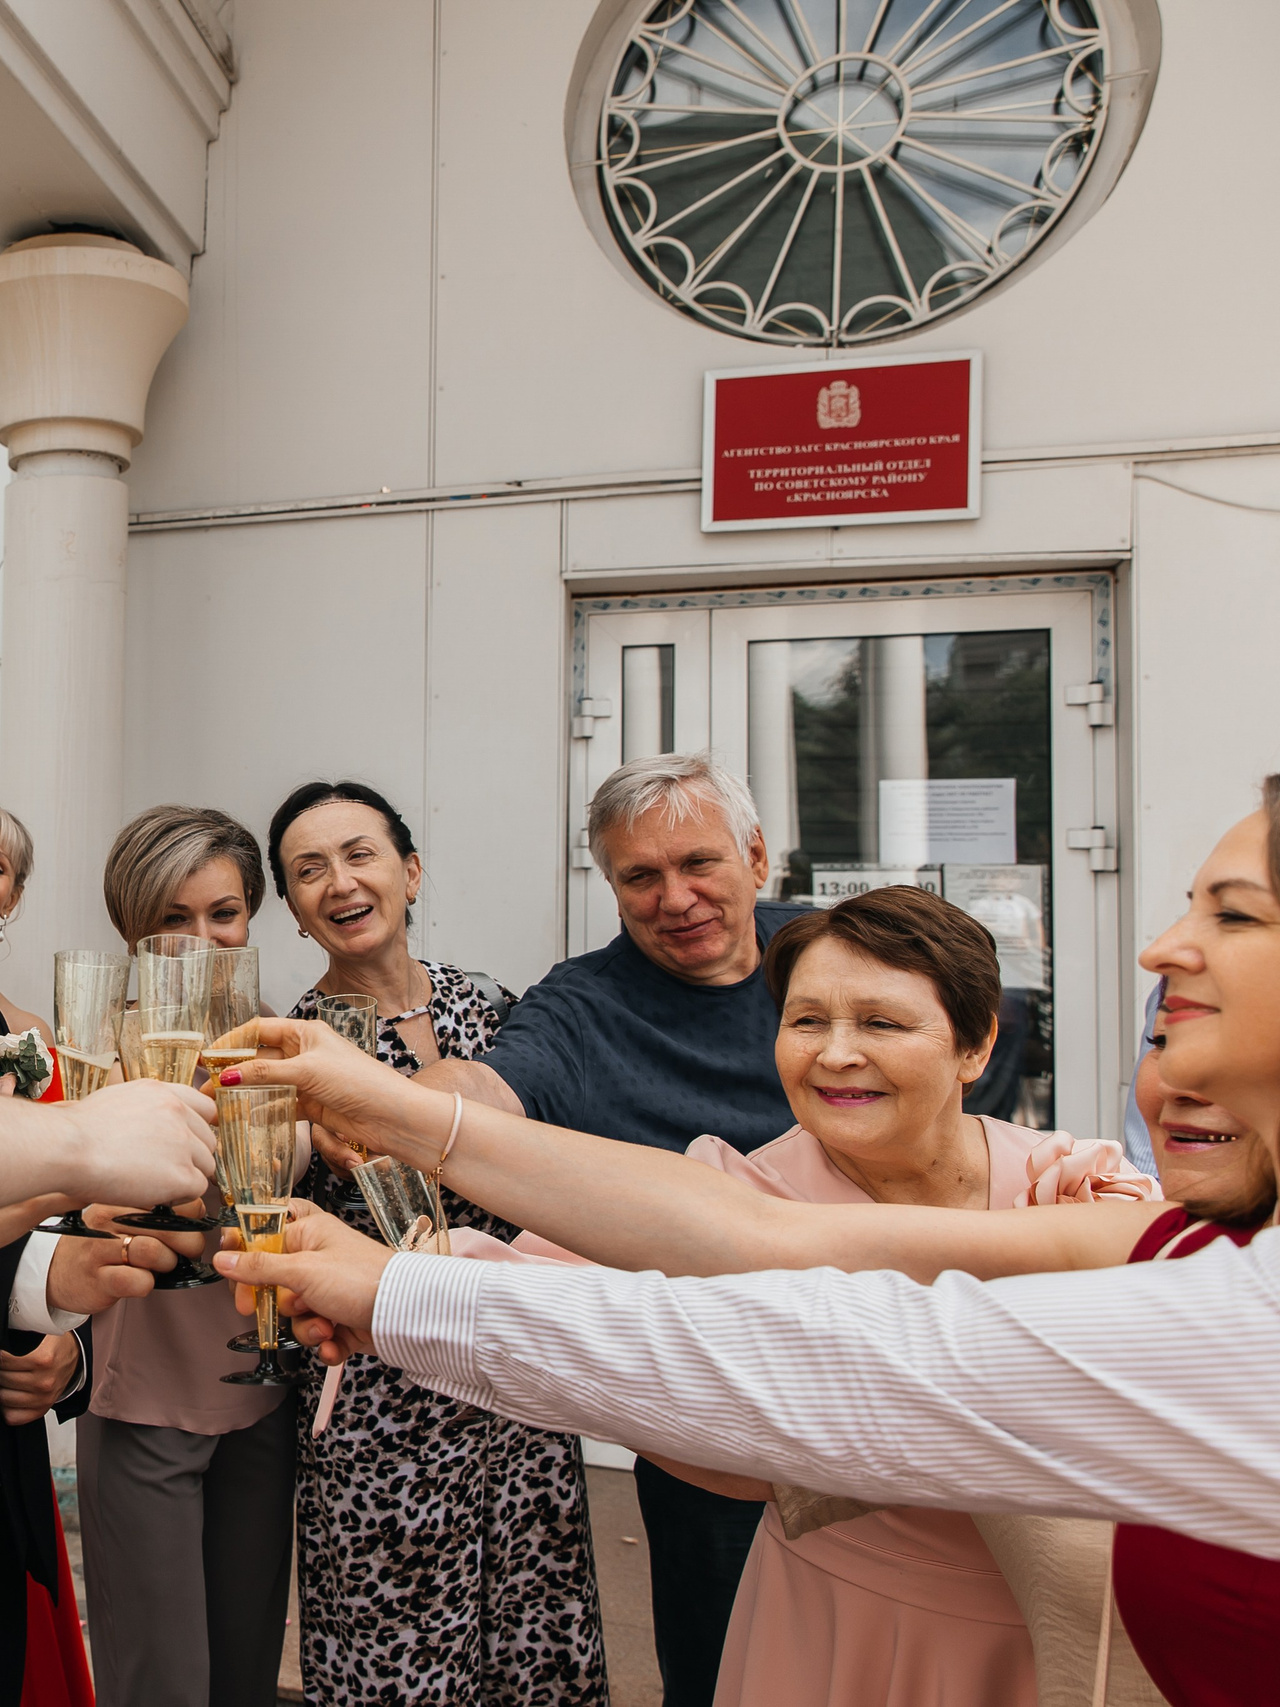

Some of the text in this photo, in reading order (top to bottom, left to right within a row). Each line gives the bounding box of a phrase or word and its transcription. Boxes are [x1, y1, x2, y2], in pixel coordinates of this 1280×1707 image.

[722, 434, 960, 458] АГЕНТСТВО ЗАГС КРАСНОЯРСКОГО КРАЯ
[748, 459, 931, 478] ТЕРРИТОРИАЛЬНЫЙ ОТДЕЛ
[754, 472, 927, 491] ПО СОВЕТСКОМУ РАЙОНУ
[819, 882, 869, 895] 13:00
